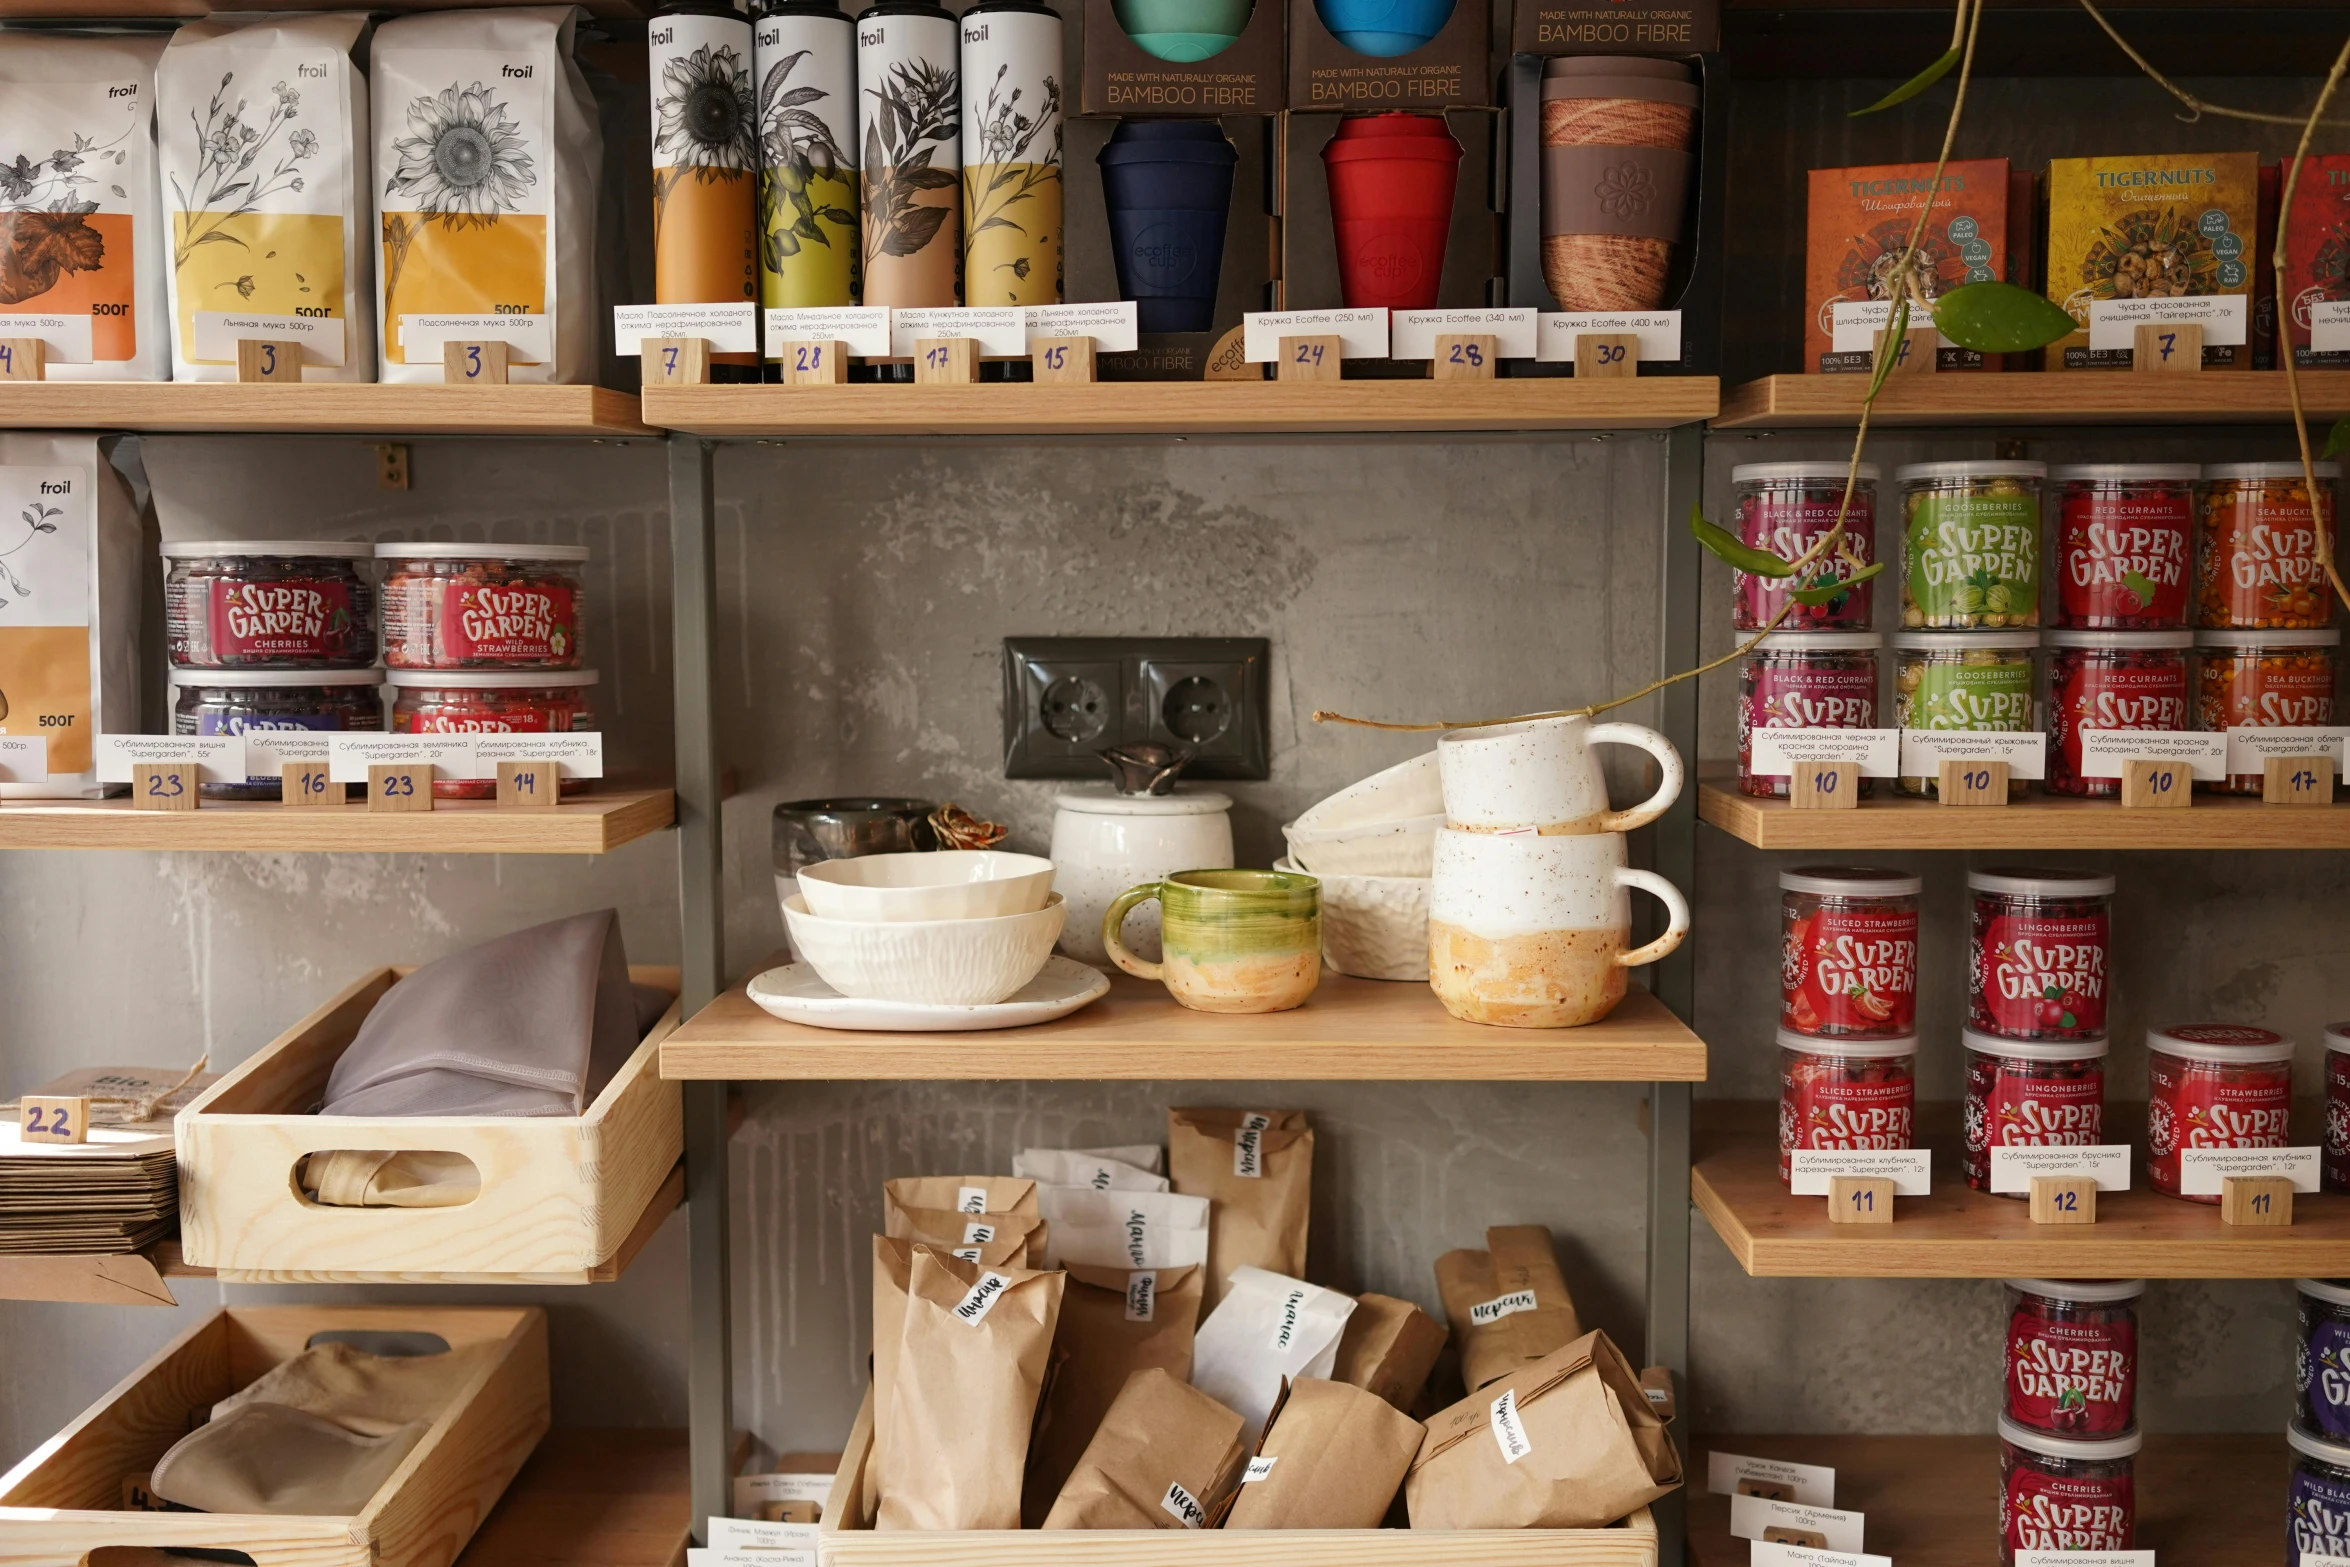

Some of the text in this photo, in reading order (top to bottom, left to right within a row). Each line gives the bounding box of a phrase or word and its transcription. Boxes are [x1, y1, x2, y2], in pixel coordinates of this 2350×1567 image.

[1540, 11, 1692, 20] MADE WITH NATURALLY ORGANIC
[651, 28, 673, 47] froil
[757, 28, 780, 48] froil
[860, 28, 885, 48] froil
[964, 24, 989, 44] froil
[1538, 24, 1691, 42] BAMBOO FIBRE
[298, 63, 327, 78] froil
[502, 64, 533, 79] froil
[1108, 73, 1256, 83] MADE WITH NATURALLY ORGANIC
[1312, 65, 1461, 78] MADE WITH NATURALLY ORGANIC
[108, 83, 137, 99] froil
[1108, 86, 1256, 105] BAMBOO FIBRE
[1312, 78, 1461, 100] BAMBOO FIBRE
[2097, 168, 2216, 188] TIGERNUTS
[1953, 231, 1974, 239] PALEO
[1965, 254, 1987, 262] VEGAN
[617, 309, 752, 320] Масло Подсолнечное холодного
[900, 310, 1014, 321] Масло Кунжутное холодного
[1041, 309, 1074, 318] Льняное
[1077, 308, 1119, 317] холодного
[2118, 301, 2211, 312] Чуфа фасованная
[223, 319, 286, 330] Льняная мука
[418, 318, 505, 327] Подсолнечная мука
[621, 319, 742, 330] отжима нерафинированное
[770, 312, 883, 321] Масло холодного
[900, 321, 929, 329] отжима
[932, 320, 1016, 330] нерафинированное
[1040, 317, 1126, 328] нерафинированное
[1258, 314, 1330, 327] Кружка Ecoffee
[1408, 313, 1481, 325] Кружка Ecoffee
[1553, 318, 1627, 330] Кружка Ecoffee
[770, 322, 878, 332] отжима нерафинированное
[1296, 345, 1324, 366] 24
[1449, 344, 1483, 367] 28
[1597, 345, 1626, 365] 30
[2158, 333, 2176, 361] 7
[261, 344, 276, 375] 3
[466, 346, 482, 378] 3
[662, 347, 679, 376] 7
[796, 346, 822, 372] 28
[926, 346, 949, 370] 17
[1044, 346, 1068, 370] 15
[40, 481, 71, 494] froil
[1945, 503, 2022, 511] GOOSEBERRIES
[1938, 521, 2034, 561] SUPER
[2088, 523, 2183, 563] SUPER
[1922, 548, 2033, 586] GARDEN
[2070, 549, 2181, 586] GARDEN
[241, 584, 325, 619] SUPER
[477, 588, 553, 621] SUPER
[228, 604, 323, 639] GARDEN
[462, 608, 551, 641] GARDEN
[255, 640, 309, 648] CHERRIES
[477, 645, 548, 653] STRAWBERRIES
[1774, 675, 1873, 684] BLACK RED CURRANTS
[1956, 671, 2026, 679] GOOSEBERRIES
[2104, 675, 2177, 683] RED CURRANTS
[1784, 692, 1872, 729] SUPER
[1949, 689, 2032, 724] SUPER
[2097, 692, 2184, 731] SUPER
[114, 740, 196, 750] Сублимированная
[339, 740, 419, 750] Сублимированная
[423, 740, 468, 749] земляника
[1762, 733, 1842, 742] Сублимированная
[1819, 743, 1868, 751] смородина
[1913, 735, 2038, 746] Сублимированный крыжовник
[2090, 735, 2209, 746] Сублимированная красная
[2239, 735, 2314, 743] Сублимированная
[2090, 746, 2140, 754] смородина
[149, 775, 184, 797] 23
[301, 773, 325, 795] 16
[384, 776, 414, 796] 23
[513, 773, 535, 794] 14
[1815, 771, 1837, 793] 10
[1964, 770, 1990, 790] 10
[2149, 770, 2173, 794] 10
[2291, 771, 2317, 791] 17
[1828, 919, 1861, 927] SLICED
[1836, 935, 1916, 970] SUPER
[2015, 939, 2104, 977] SUPER
[1818, 959, 1914, 996] GARDEN
[1997, 963, 2102, 999] GARDEN
[1819, 1087, 1853, 1096] SLICED
[2026, 1083, 2097, 1092] LINGONBERRIES
[2220, 1088, 2283, 1096] STRAWBERRIES
[26, 1106, 70, 1137] 22
[1829, 1104, 1911, 1138] SUPER
[2022, 1100, 2101, 1135] SUPER
[2210, 1104, 2289, 1139] SUPER
[1800, 1156, 1875, 1165] Сублимированная
[2002, 1151, 2121, 1160] Сублимированная брусника
[2185, 1154, 2268, 1163] Сублимированная
[1852, 1190, 1873, 1212] 11
[2055, 1191, 2078, 1211] 12
[2251, 1193, 2270, 1214] 11
[1278, 1290, 1303, 1349] Ананас
[2049, 1327, 2099, 1337] CHERRIES
[2030, 1339, 2125, 1381] SUPER
[2016, 1359, 2122, 1402] GARDEN
[2052, 1482, 2102, 1493] CHERRIES
[2304, 1480, 2325, 1493] WILD
[1772, 1503, 1846, 1522] Персик (Армения)
[2033, 1494, 2125, 1534] SUPER
[1788, 1551, 1856, 1566] Манго (Тайланд)
[2030, 1557, 2107, 1567] Сублимированная
